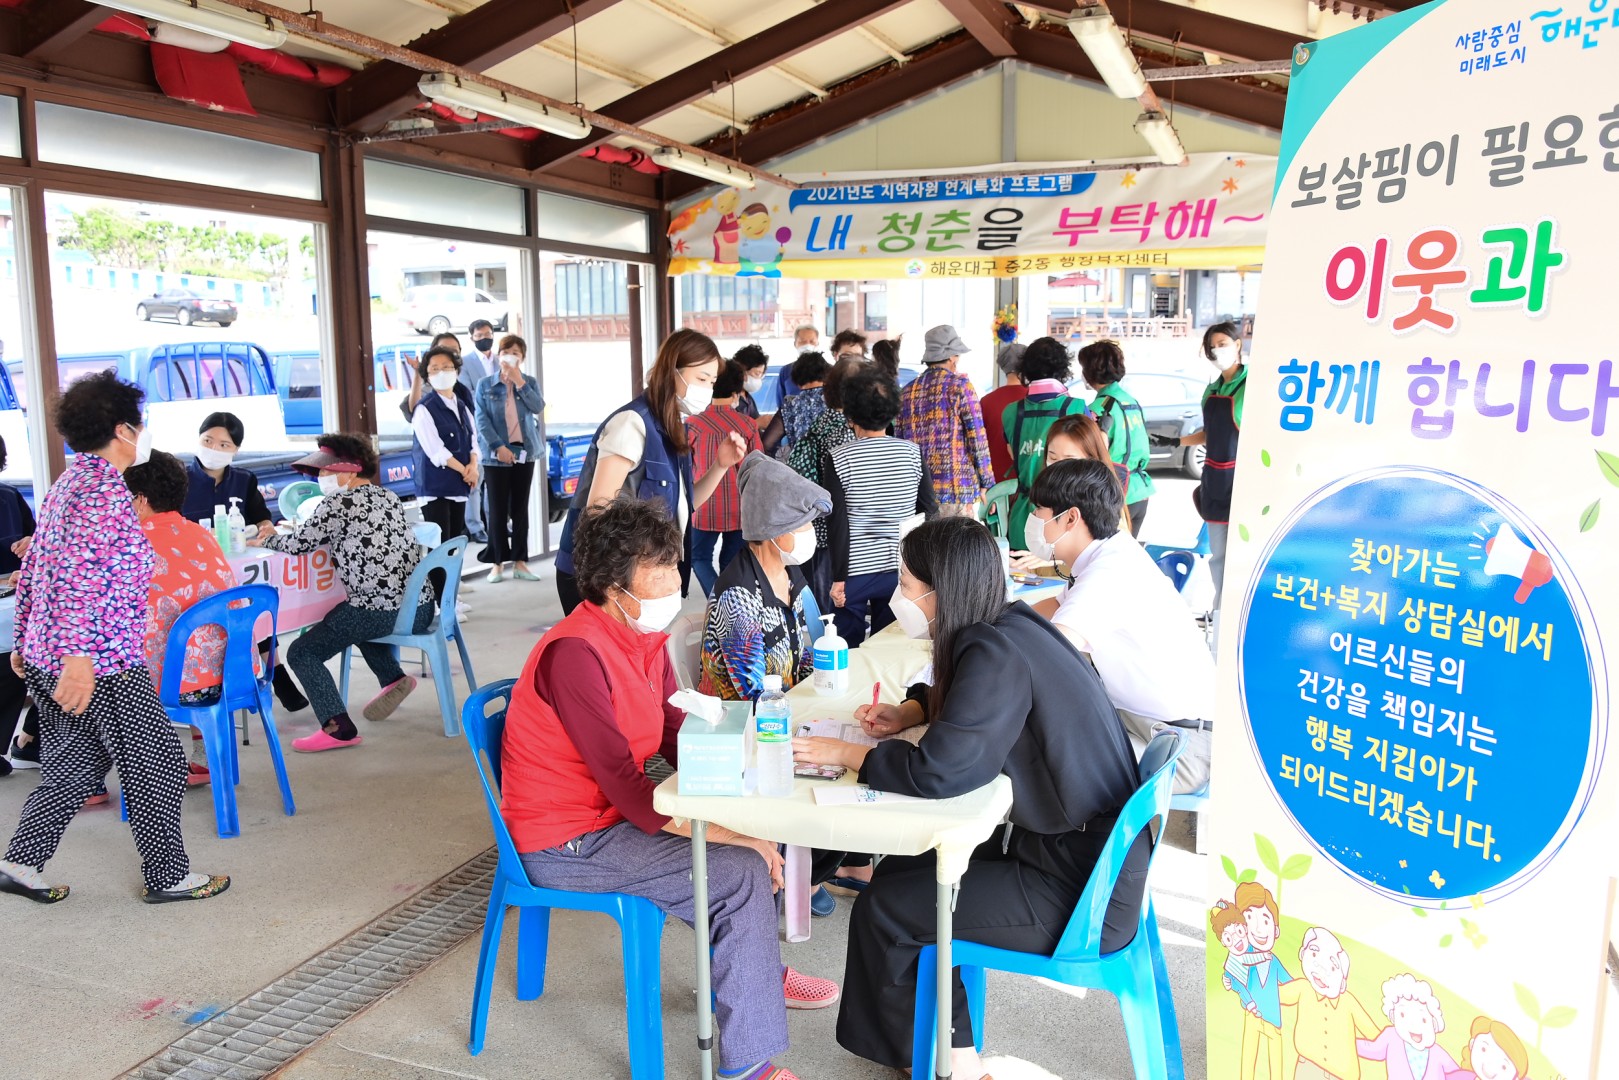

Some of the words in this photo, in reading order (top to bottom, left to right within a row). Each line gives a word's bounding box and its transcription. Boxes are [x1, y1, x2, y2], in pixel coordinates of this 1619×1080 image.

[1455, 20, 1521, 53] 사람중심
[1529, 0, 1619, 49] 해운
[1460, 46, 1526, 75] 미래도시
[807, 185, 875, 201] 2021년도
[881, 181, 938, 199] 지역자원
[945, 176, 1004, 196] 연계특화
[1010, 174, 1073, 193] 프로그램
[1291, 134, 1460, 211] 보살핌이
[806, 214, 853, 253] 내
[877, 207, 1024, 253] 청춘을
[930, 260, 998, 276] 해운대구
[1325, 220, 1563, 330] 이웃과
[1278, 358, 1381, 432] 함께
[1406, 356, 1619, 440] 합니다
[388, 465, 411, 482] KIA
[283, 550, 334, 591] 네일
[1348, 537, 1460, 589] 찾아가는
[1272, 573, 1387, 625] 보건+복지
[1398, 596, 1554, 661] 상담실에서
[1329, 631, 1465, 694] 어르신들의
[1297, 668, 1370, 719] 건강을
[1381, 690, 1497, 756] 책임지는
[1305, 715, 1353, 760] 행복
[1363, 735, 1478, 801] 지킴이가
[1279, 753, 1502, 863] 되어드리겠습니다.
